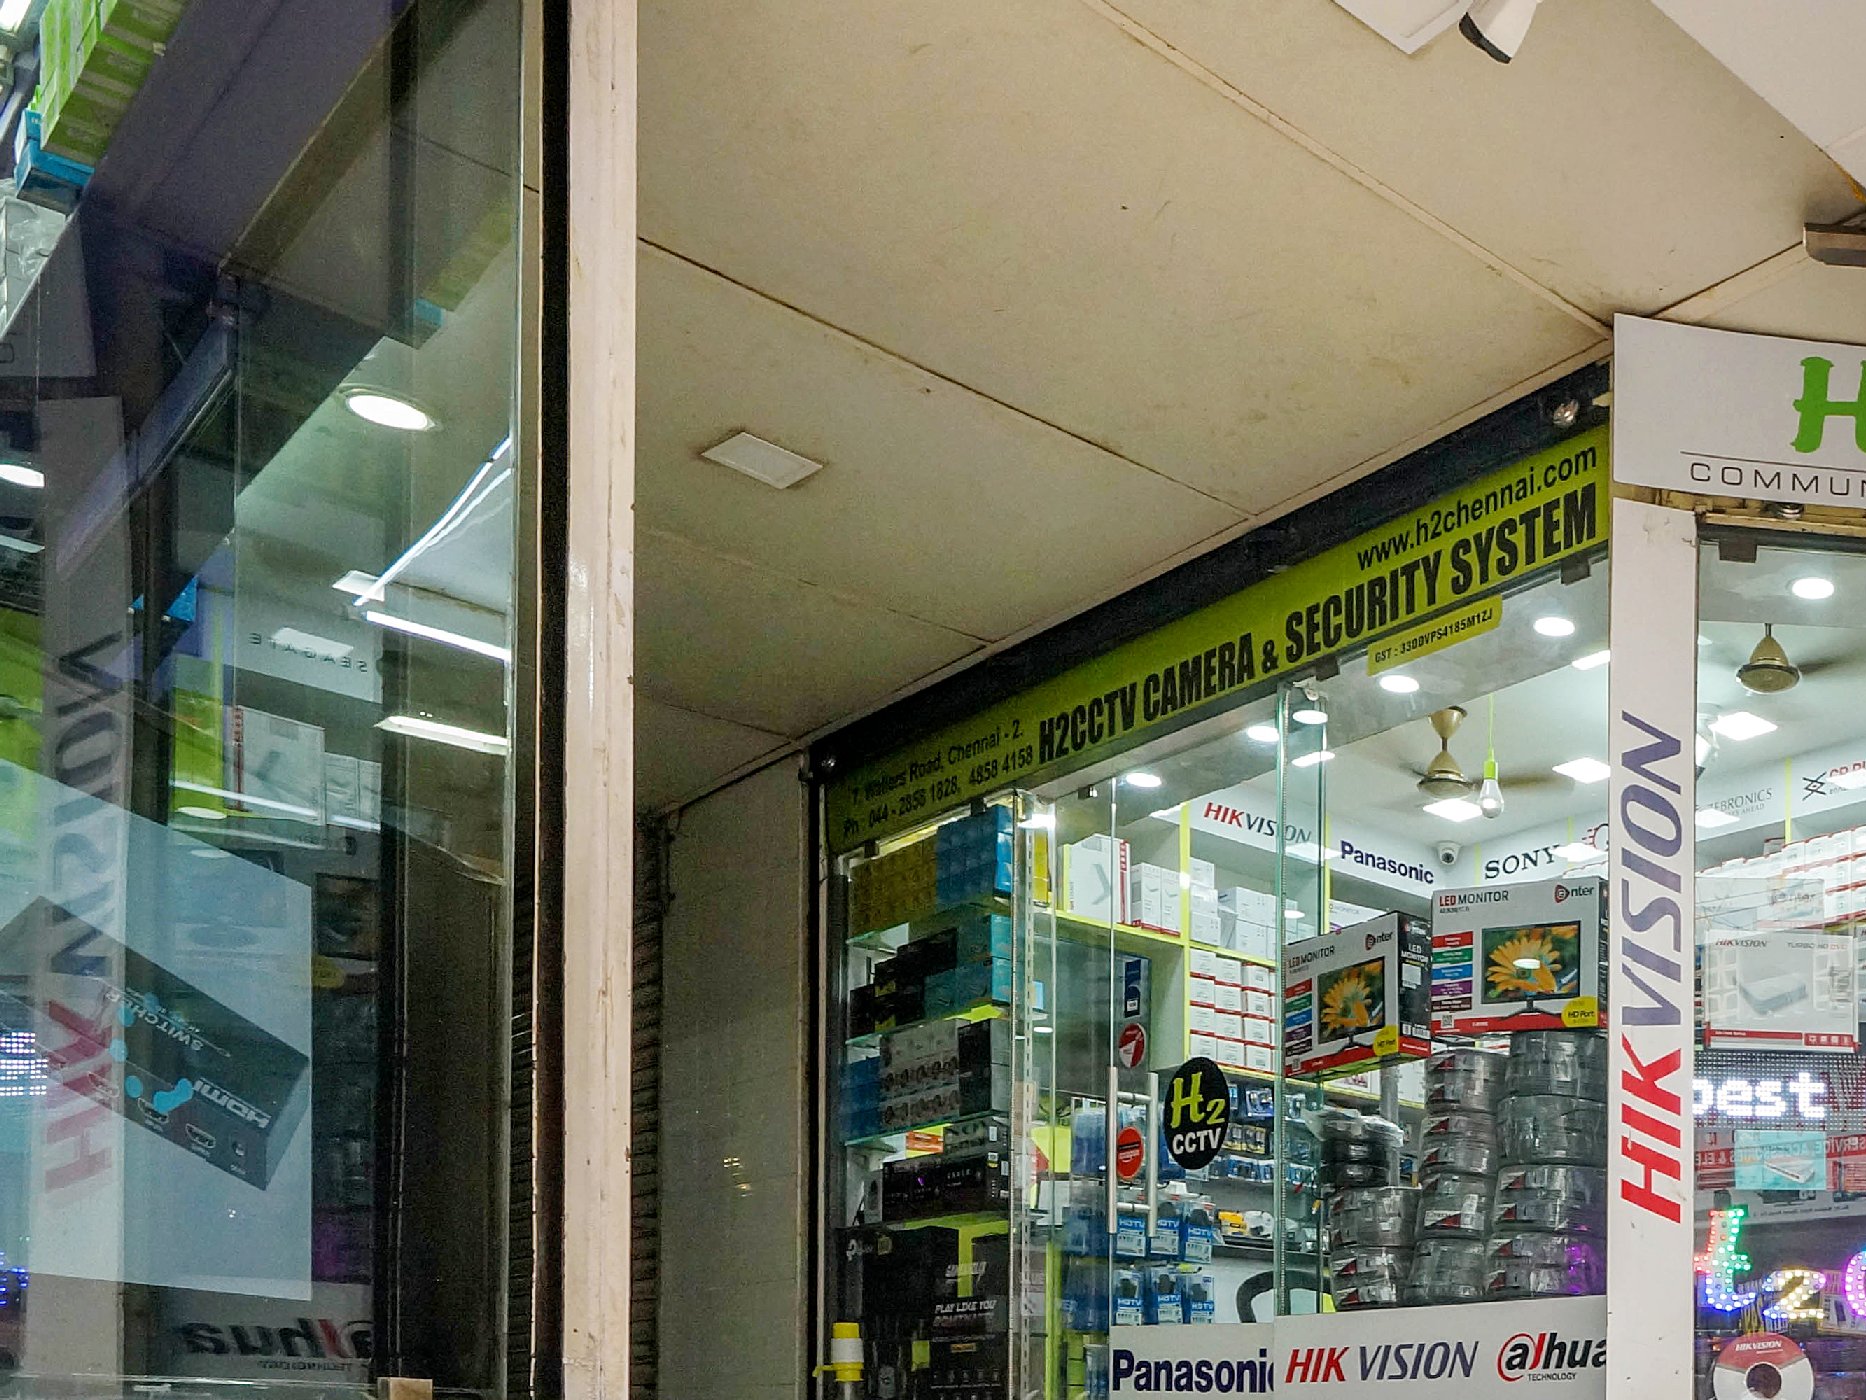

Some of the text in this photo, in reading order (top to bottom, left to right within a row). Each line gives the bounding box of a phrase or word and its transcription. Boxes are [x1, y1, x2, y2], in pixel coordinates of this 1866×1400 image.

[1356, 445, 1598, 572] www.h2chennai.com
[1038, 481, 1598, 766] H2CCTV CAMERA & SECURITY SYSTEM
[1374, 647, 1393, 663] GST
[947, 726, 1001, 764] Chennai
[1203, 801, 1313, 844] HIKVISION
[1339, 839, 1435, 885] Panasonic
[1483, 844, 1561, 881] SONY
[1439, 890, 1510, 907] LED MONITOR
[1620, 709, 1683, 1225] HIKVISION
[192, 1076, 273, 1131] HDMI
[1172, 1127, 1223, 1156] CCTV
[1527, 1372, 1578, 1382] TECHNOLOGY
